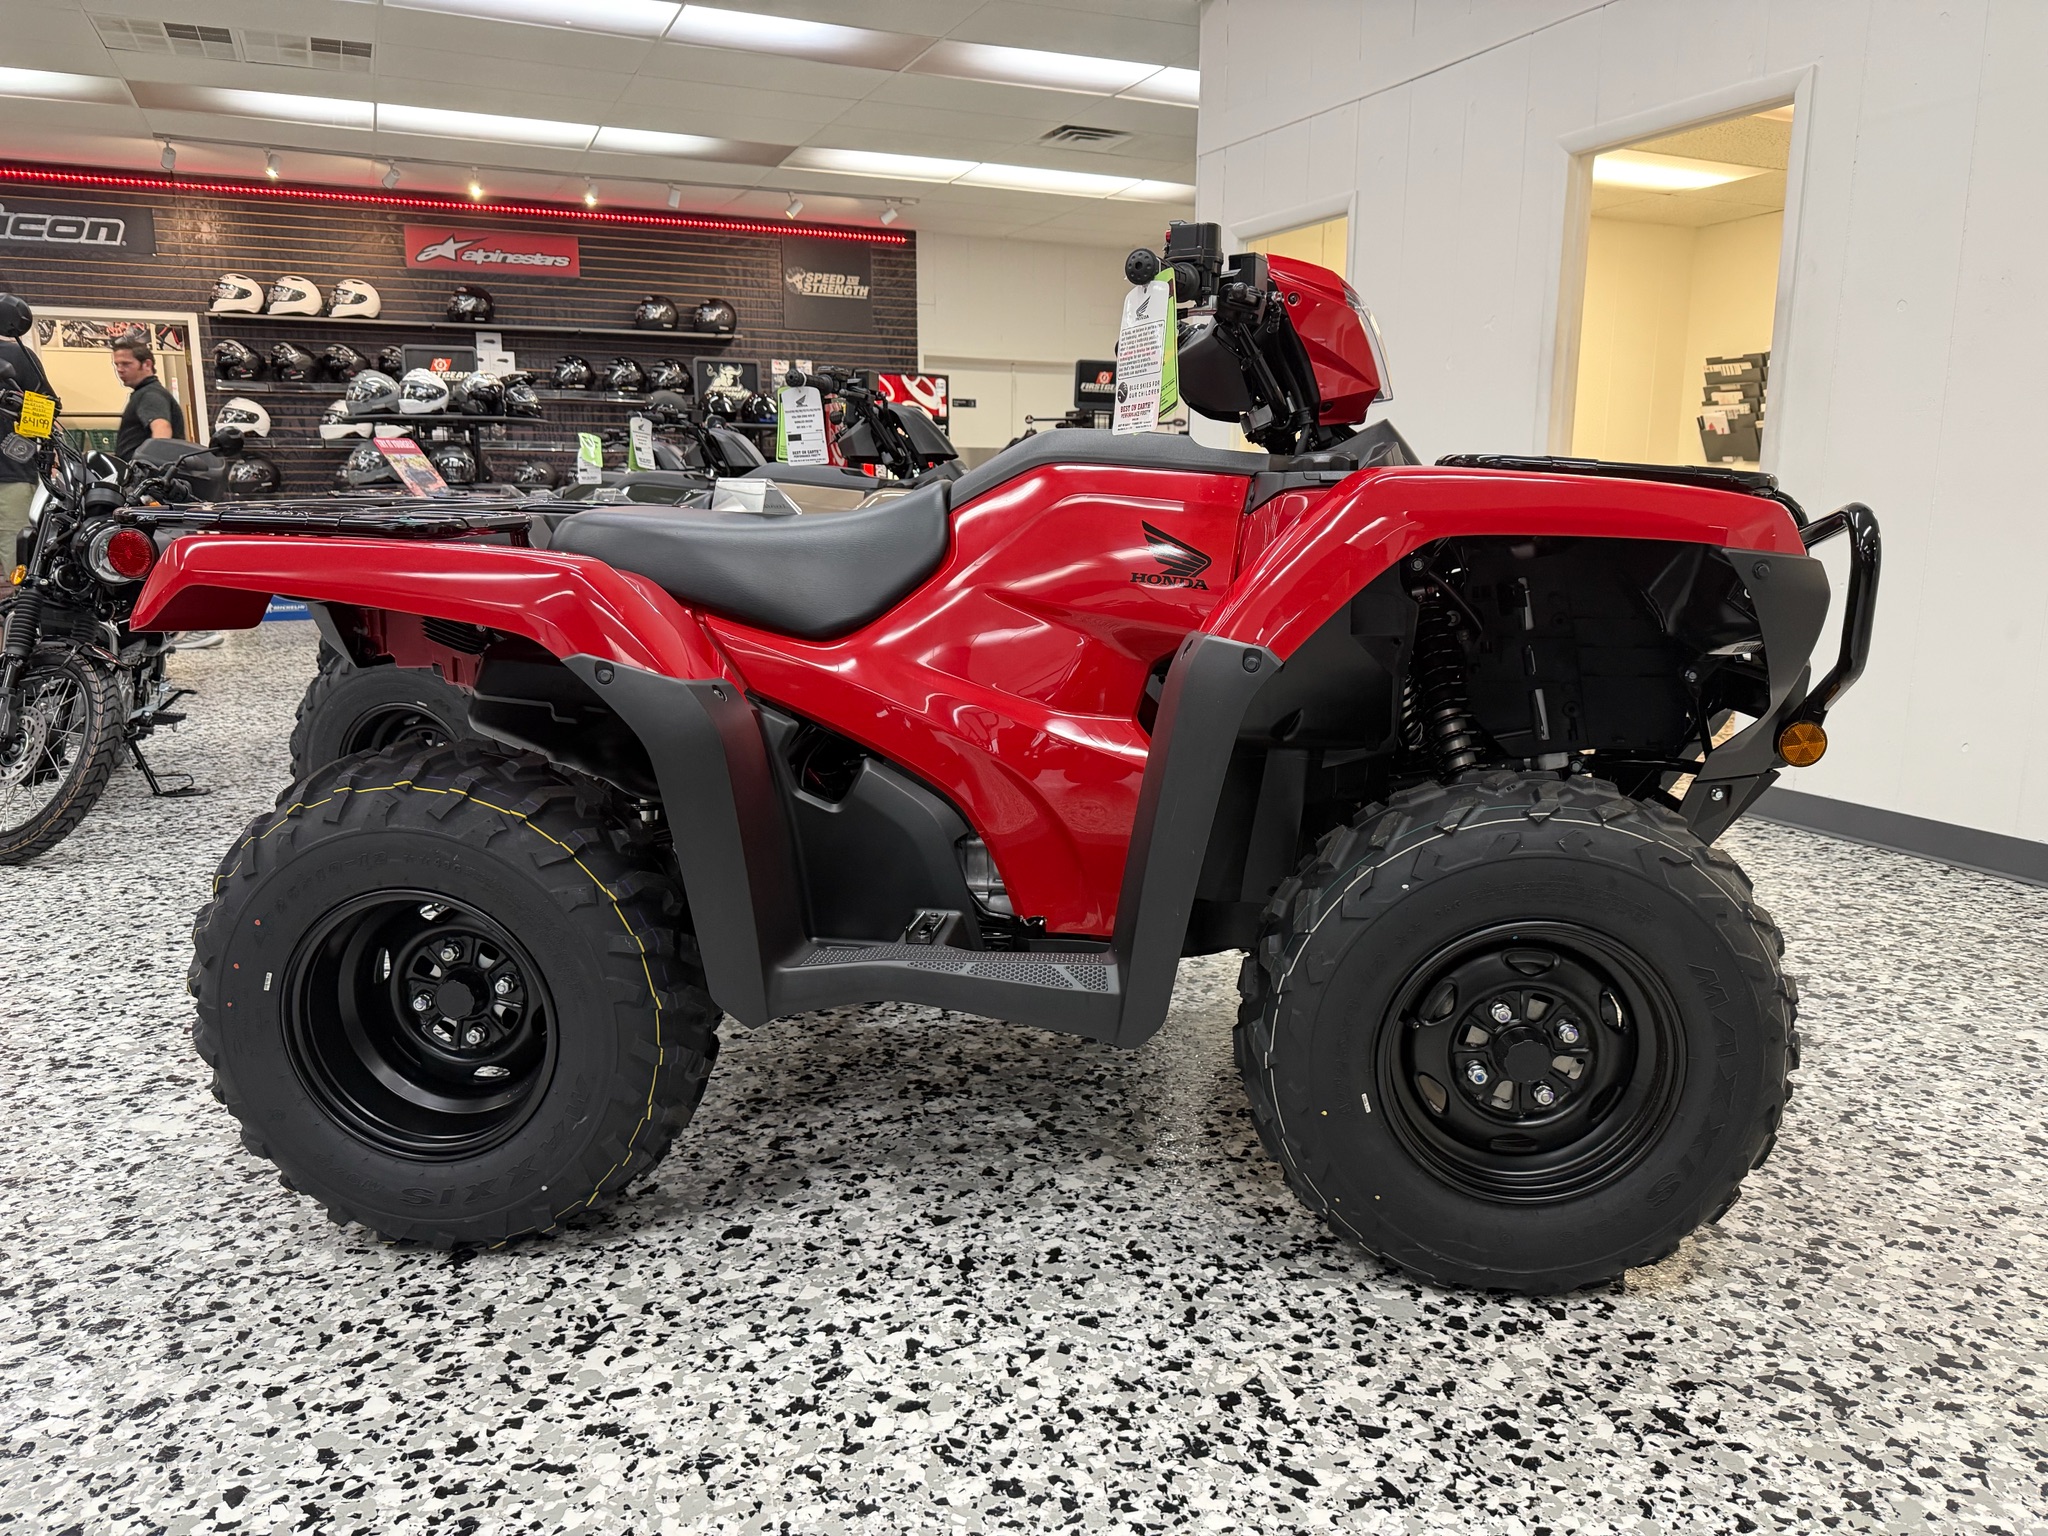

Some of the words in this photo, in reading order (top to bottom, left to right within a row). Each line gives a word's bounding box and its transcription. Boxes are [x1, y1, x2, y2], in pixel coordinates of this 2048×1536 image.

[461, 249, 571, 268] alpinestars
[805, 271, 846, 285] SPEED
[803, 282, 870, 297] STRENGTH
[22, 416, 50, 429] $4199
[1130, 572, 1209, 591] HONDA
[1648, 962, 1740, 1209] MAXXIS
